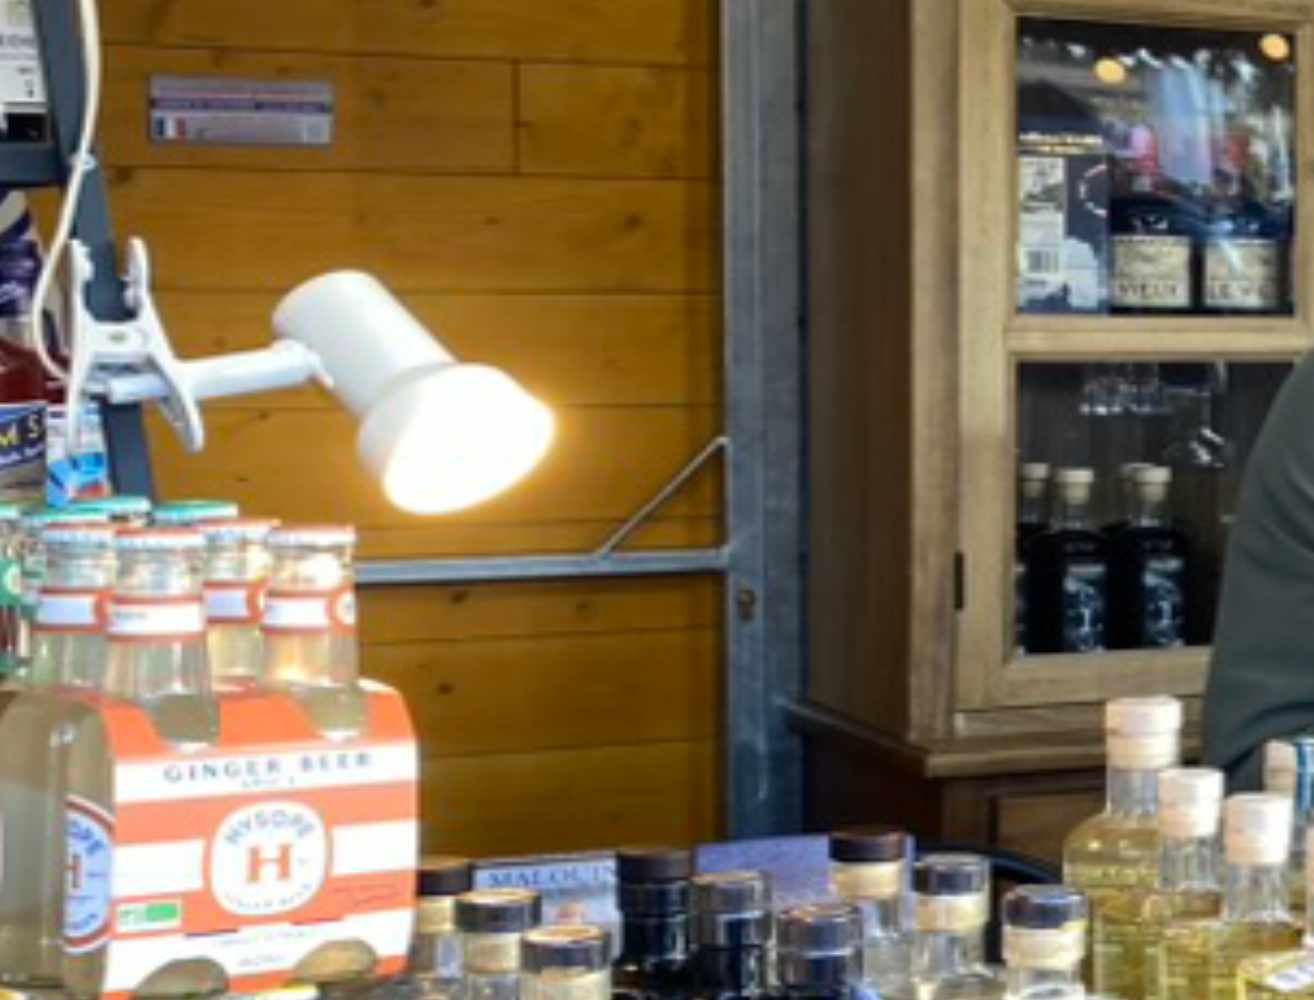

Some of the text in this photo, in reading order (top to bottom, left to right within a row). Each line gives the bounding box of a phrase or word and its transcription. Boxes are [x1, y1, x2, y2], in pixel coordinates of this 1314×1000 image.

[163, 758, 281, 783] GINGER
[301, 751, 371, 772] BEER
[245, 842, 291, 884] H
